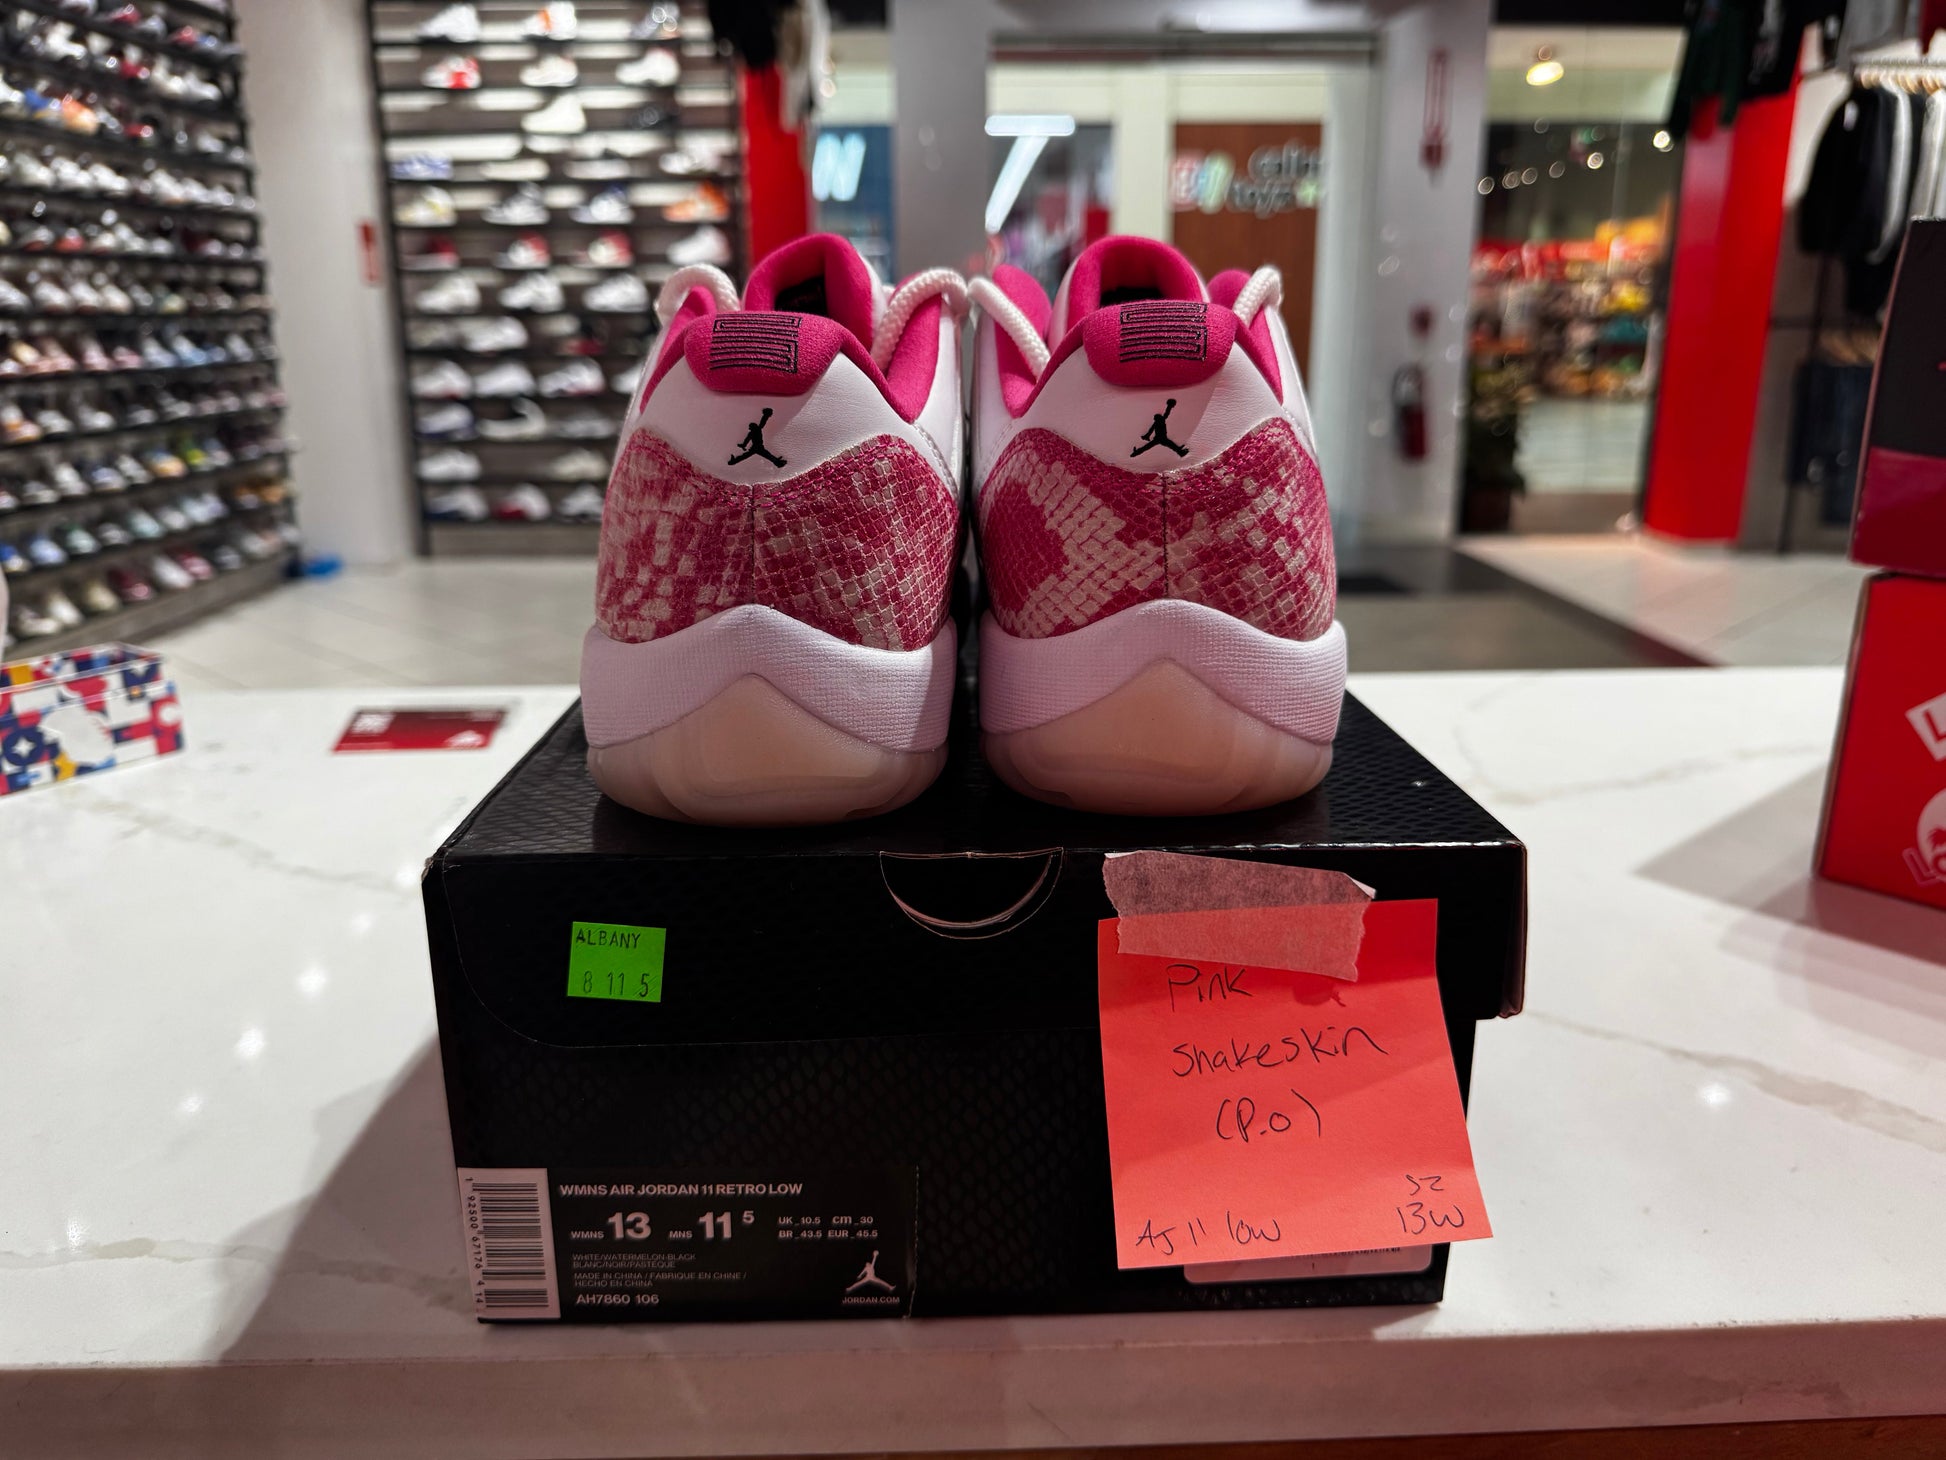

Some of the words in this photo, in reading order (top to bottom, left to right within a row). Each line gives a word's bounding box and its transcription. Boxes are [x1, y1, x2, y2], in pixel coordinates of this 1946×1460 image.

[575, 928, 641, 949] ALBANY
[583, 970, 593, 994] 8
[607, 971, 626, 996] 11
[639, 973, 650, 998] 5
[1166, 963, 1253, 1013] Pink
[559, 1184, 608, 1196] WMNS
[609, 1184, 635, 1196] AIR
[637, 1184, 699, 1196] JORDAN
[701, 1184, 713, 1196] 11
[716, 1184, 767, 1195] RETRO
[769, 1183, 804, 1195] LOW
[467, 1195, 479, 1230] 92500
[571, 1230, 604, 1239] WMNS
[607, 1211, 652, 1239] 13
[668, 1230, 693, 1239] MNS
[698, 1211, 732, 1239] 11
[742, 1210, 755, 1224] 5
[471, 1235, 484, 1269] 67176
[574, 1271, 600, 1280] MADE
[602, 1271, 612, 1280] IN
[614, 1271, 643, 1280] CHINA
[698, 1271, 711, 1280] EN
[713, 1271, 741, 1280] CHINE
[574, 1279, 608, 1288] HECHO
[610, 1279, 622, 1288] EN
[624, 1279, 653, 1288] CHINA
[576, 1294, 631, 1305] AH7860
[635, 1294, 660, 1305] 106
[842, 1296, 900, 1304] JORDAN.COM
